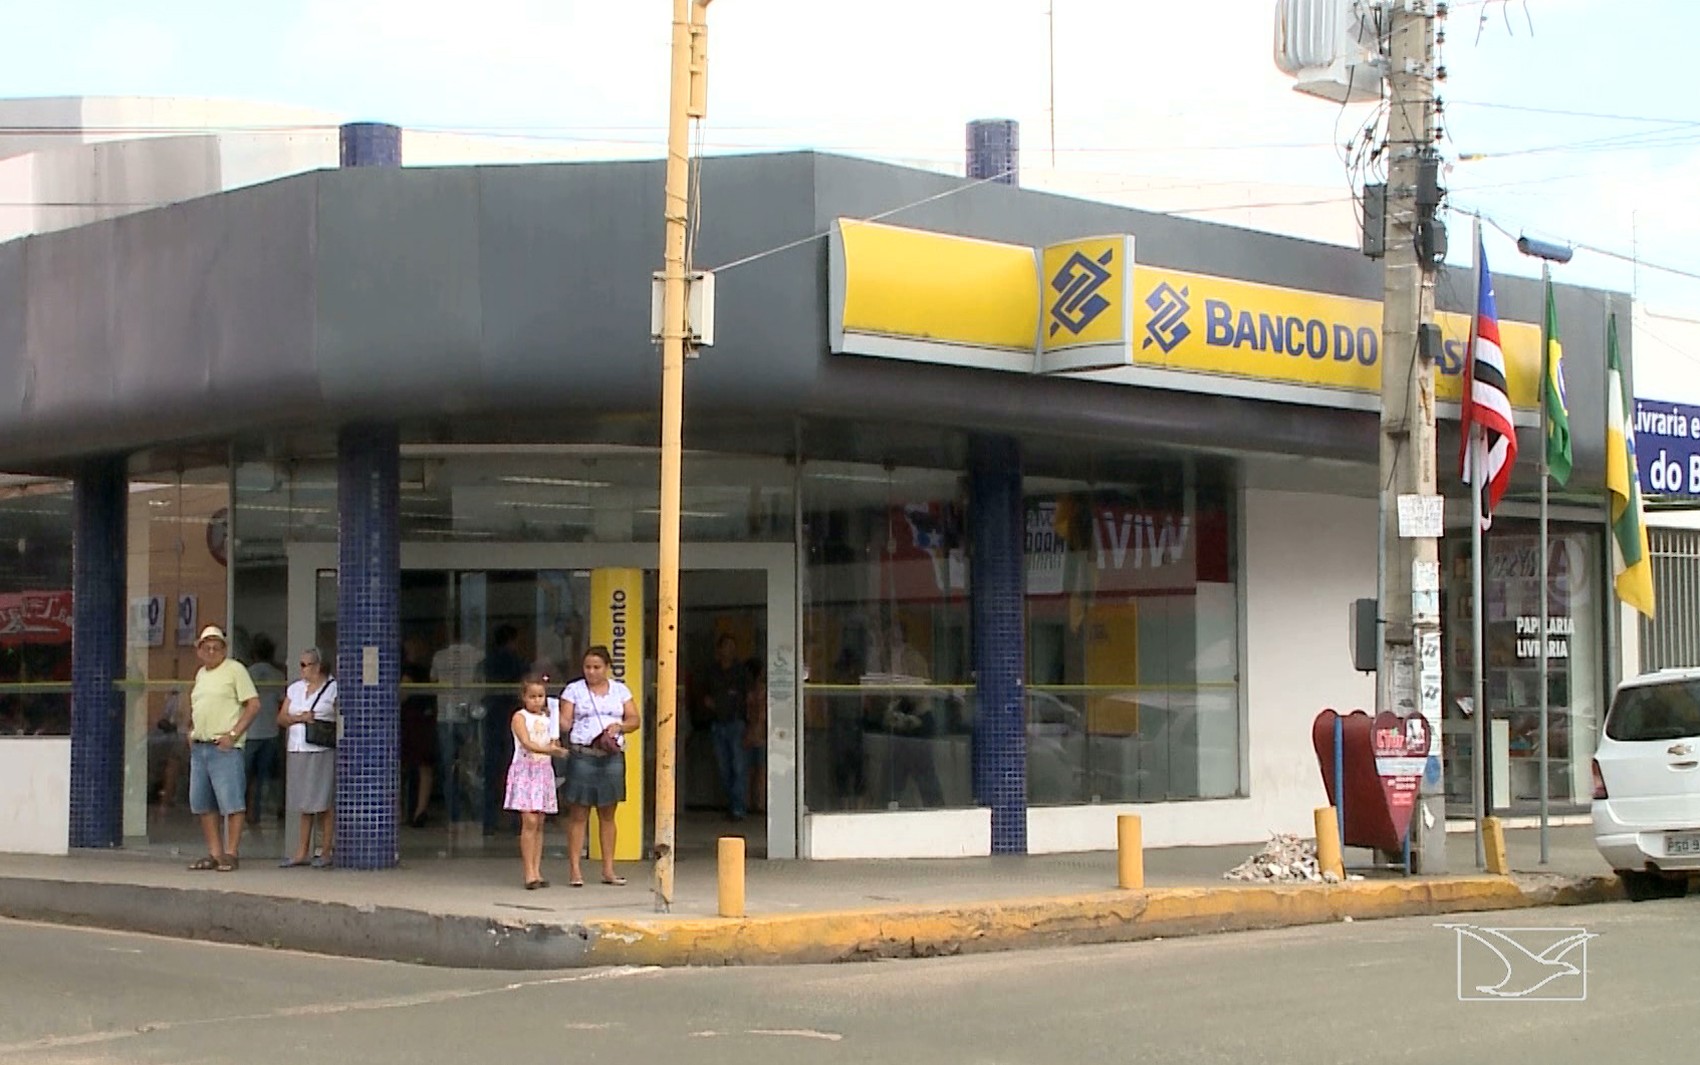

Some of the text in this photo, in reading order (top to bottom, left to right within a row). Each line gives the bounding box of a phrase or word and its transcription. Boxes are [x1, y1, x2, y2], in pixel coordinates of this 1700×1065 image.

[1205, 299, 1328, 360] BANCO
[1333, 324, 1378, 367] DO
[1634, 402, 1688, 437] ivraria
[1650, 449, 1683, 492] do
[610, 590, 626, 683] dimento
